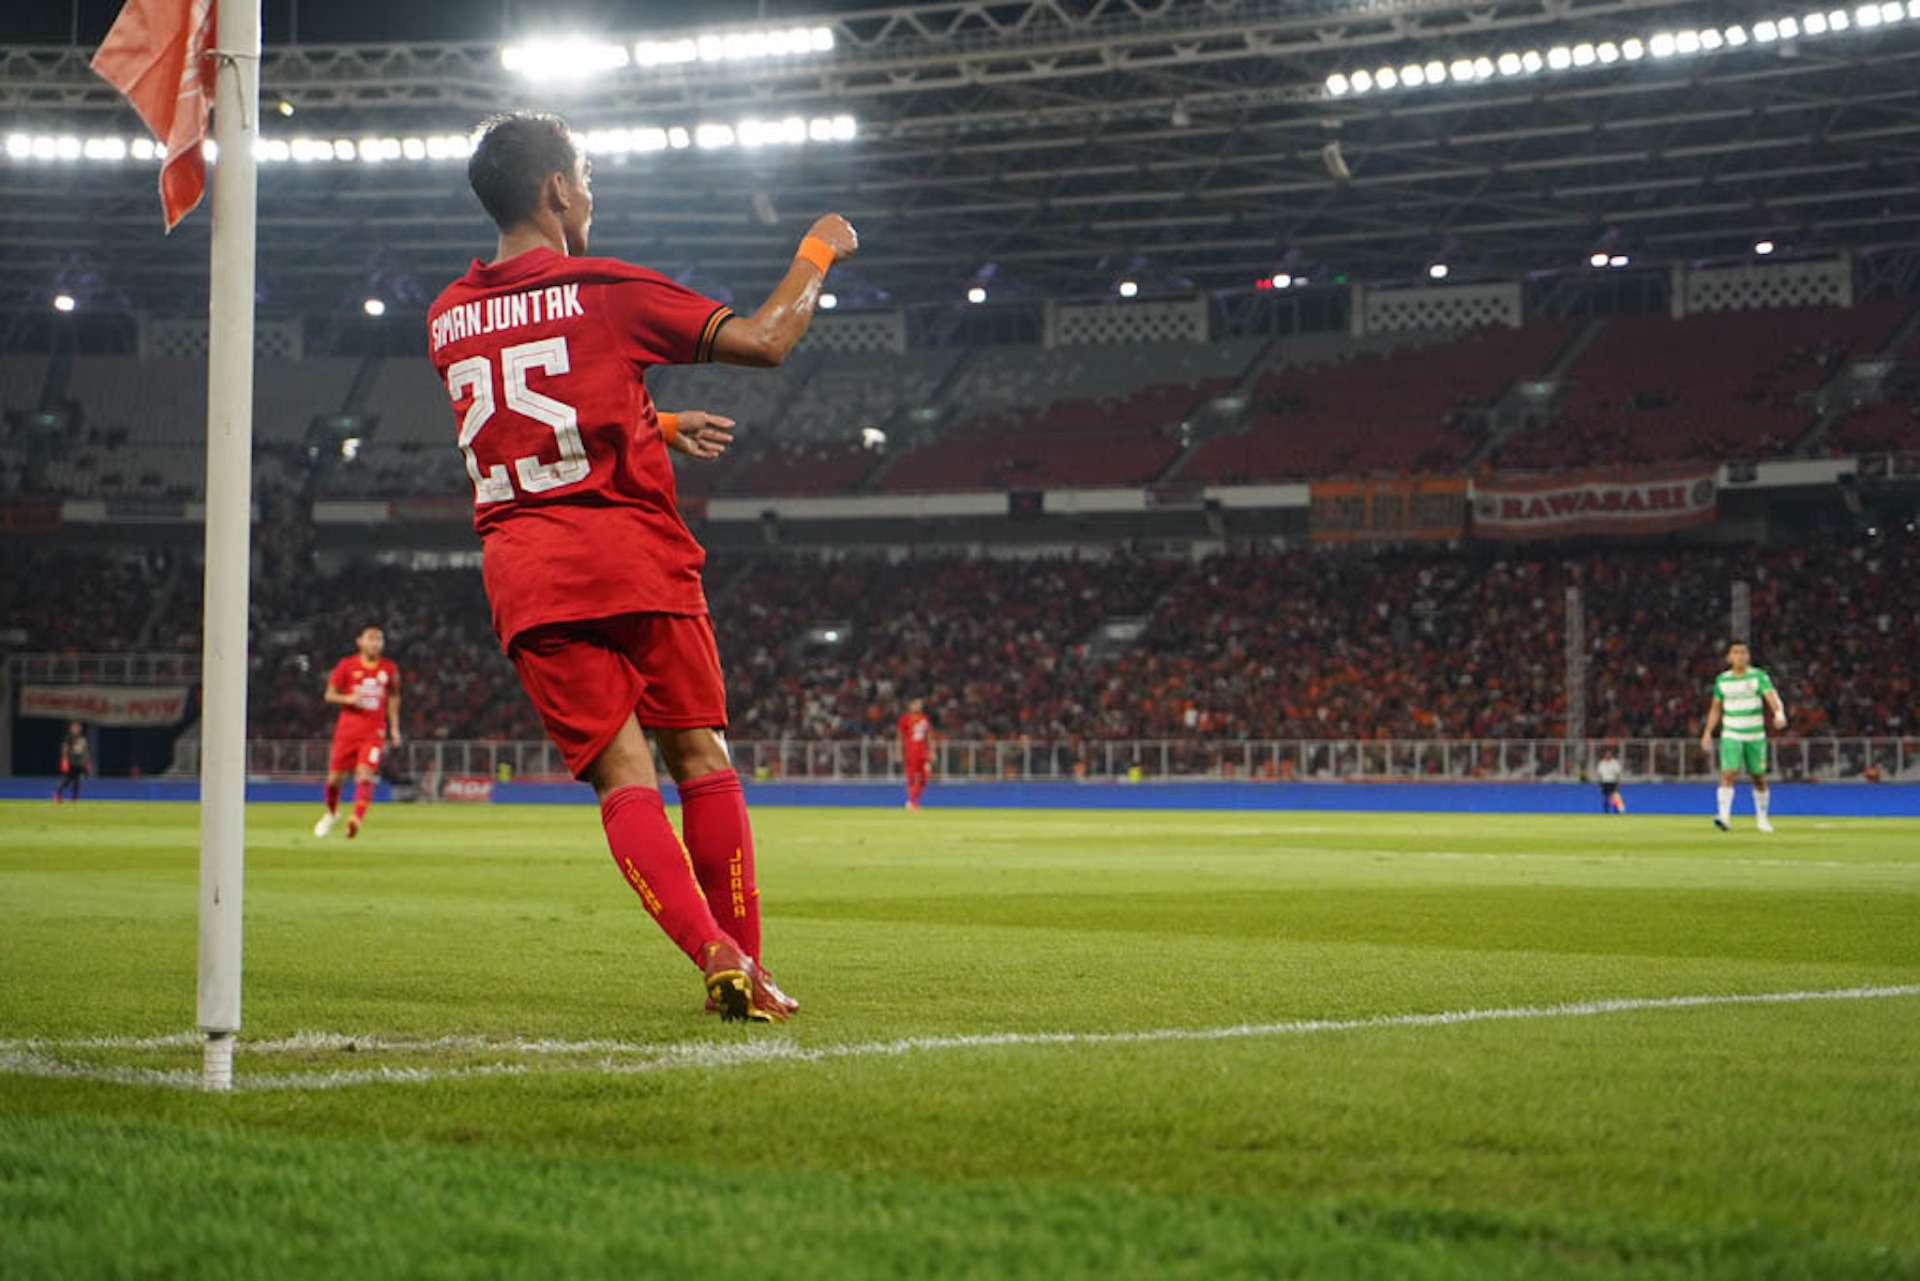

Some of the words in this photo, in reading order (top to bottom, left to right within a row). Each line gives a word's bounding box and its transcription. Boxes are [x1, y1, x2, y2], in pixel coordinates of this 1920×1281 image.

[432, 284, 584, 352] SIMANJUNTAK
[447, 336, 592, 504] 25
[1502, 486, 1687, 520] RAWASARI
